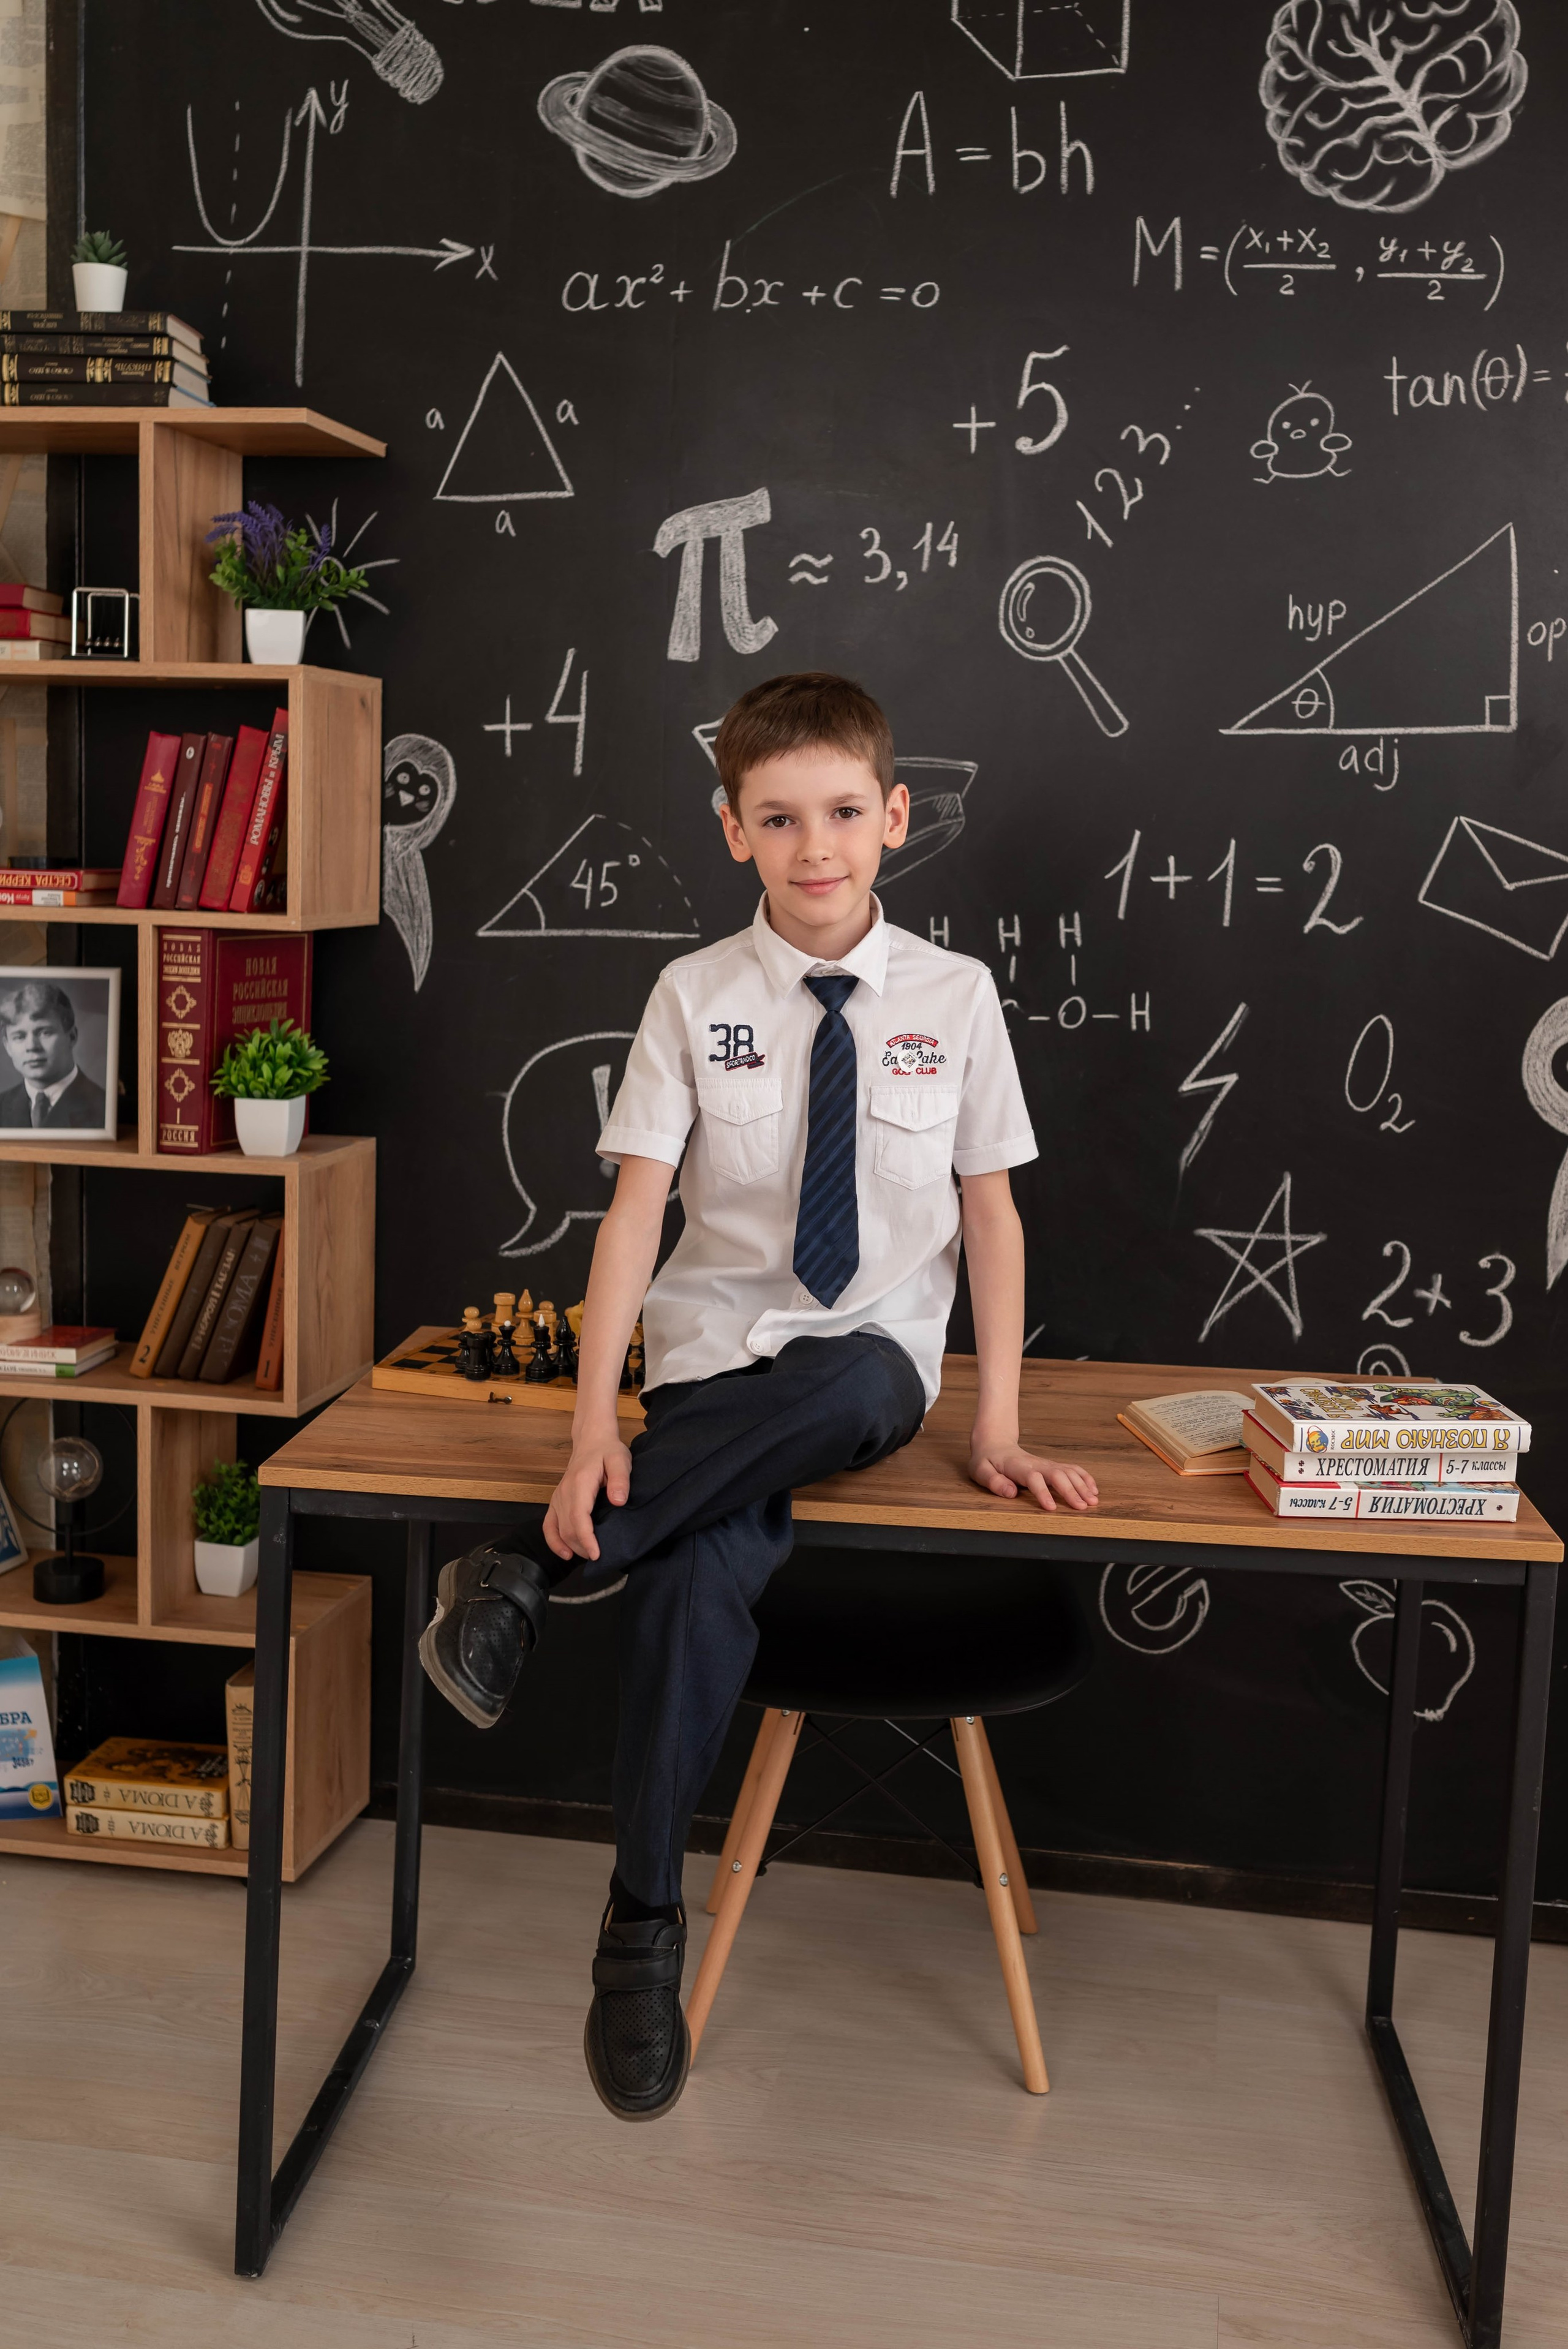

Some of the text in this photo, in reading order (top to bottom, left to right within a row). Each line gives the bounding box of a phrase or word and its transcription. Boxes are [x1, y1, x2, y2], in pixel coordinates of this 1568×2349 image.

[1288, 594, 1347, 642] hyp
[1339, 739, 1400, 791] adj
[250, 779, 274, 846] РОМАНОВЫ
[268, 733, 285, 769] КРЫМ
[36, 874, 72, 888] СЕСТРА
[0, 892, 15, 905] Ко
[246, 956, 277, 977] НОВАЯ
[233, 978, 288, 1001] РОССИЙСКАЯ
[709, 1024, 754, 1061] 38
[890, 1035, 911, 1047] ATLANTA
[902, 1042, 922, 1050] 1904
[162, 1128, 195, 1142] РОССИЯ
[1340, 1428, 1511, 1451] Я ПОЗНАЮ МИР
[1316, 1457, 1430, 1476] ХРЕСТОМАТИЯ
[1446, 1459, 1507, 1474] 5-7 классы
[1289, 1497, 1354, 1511] 5-7 классы
[1368, 1496, 1487, 1516] ХРЕСТОМАТИЯ
